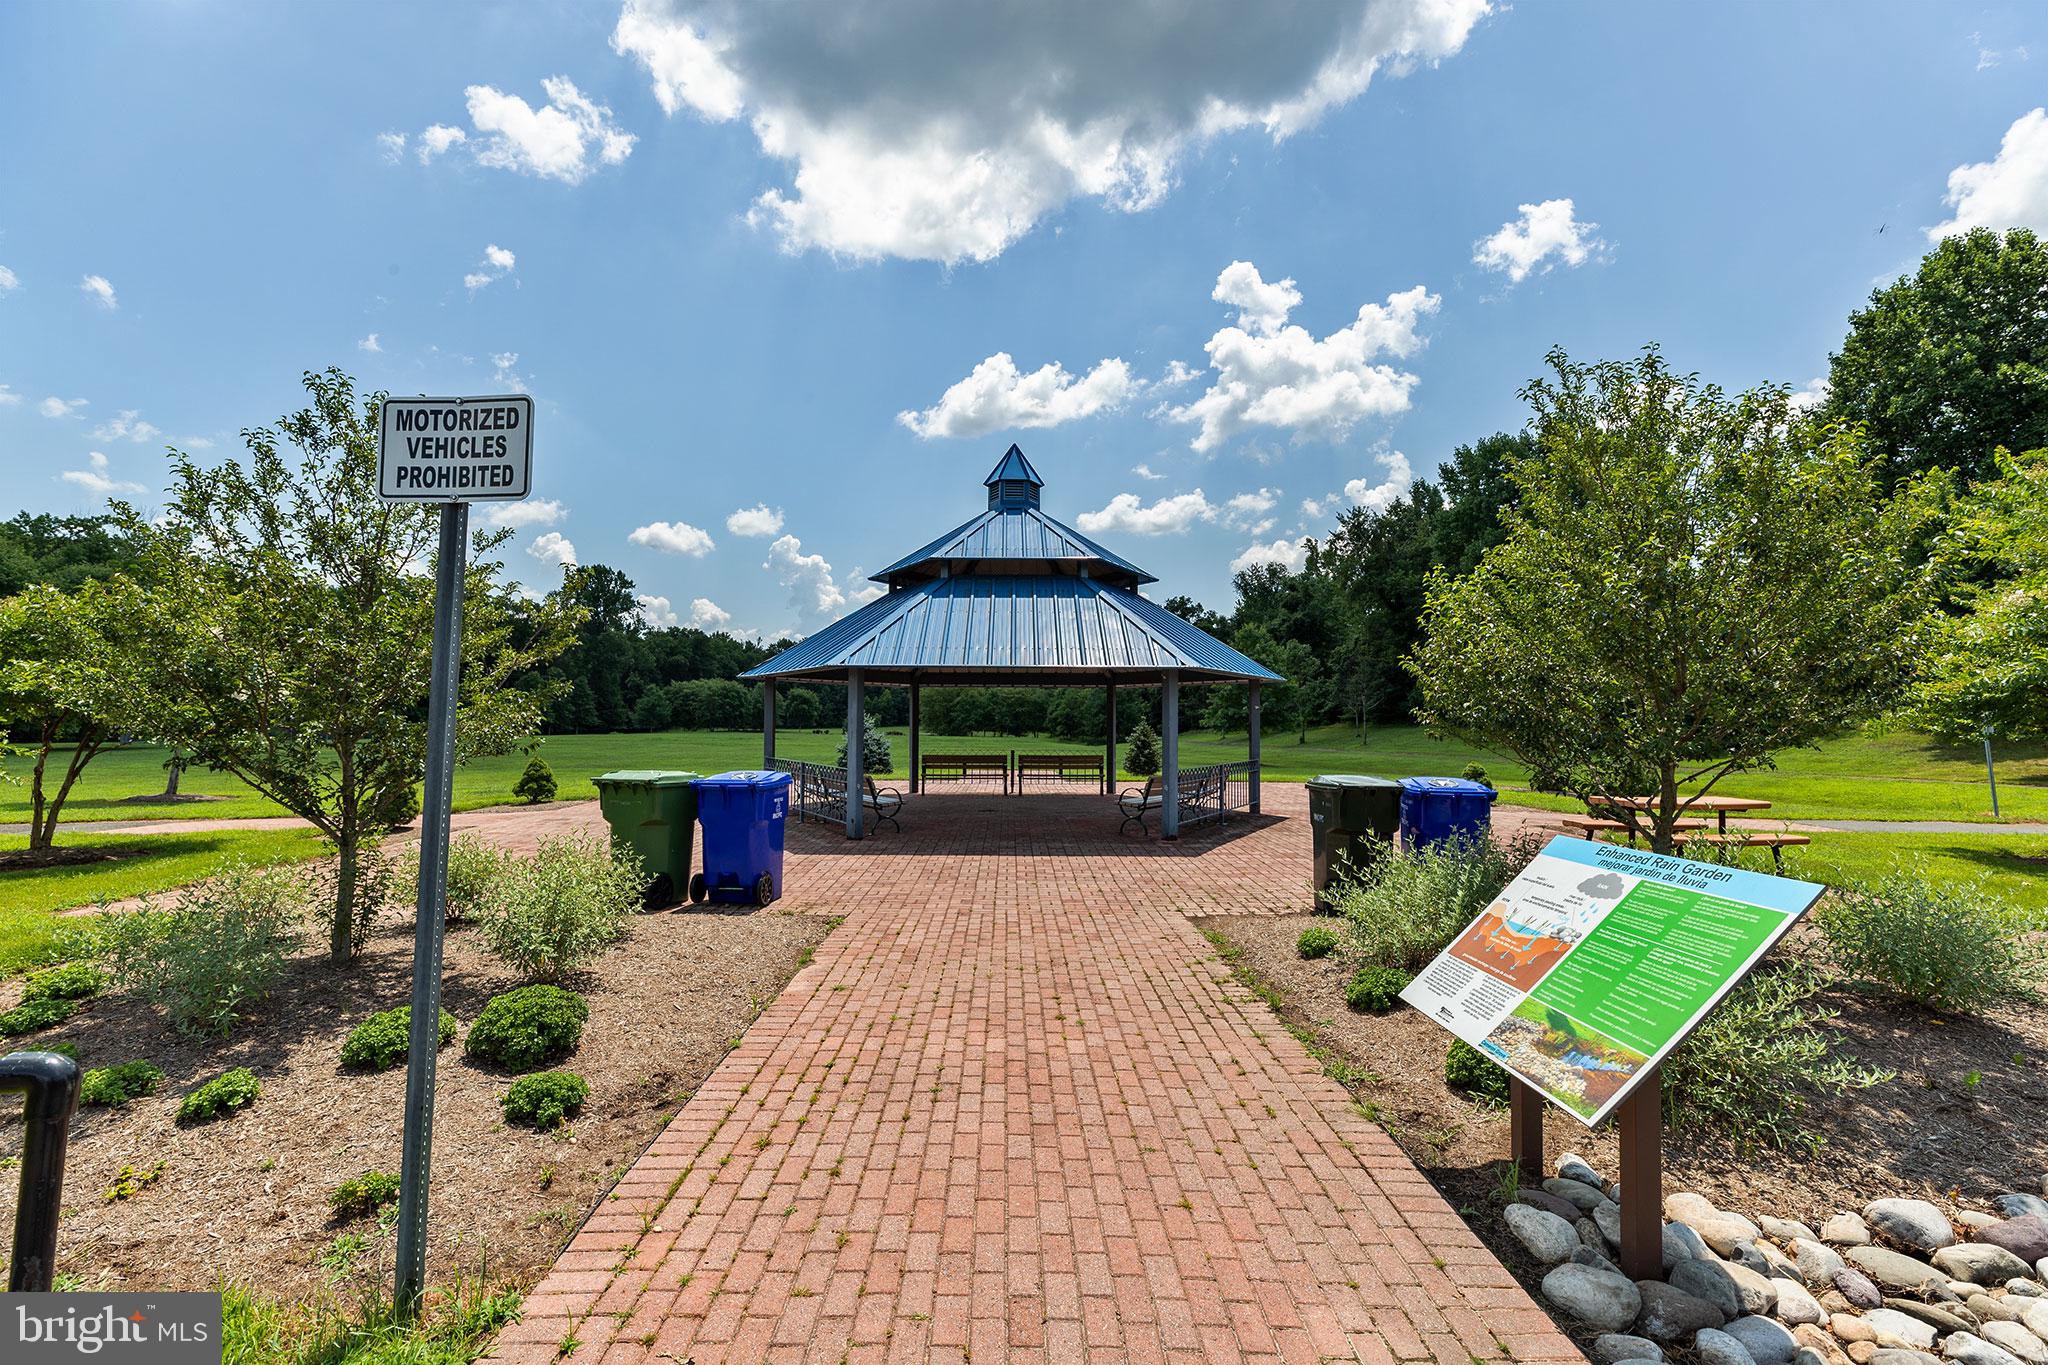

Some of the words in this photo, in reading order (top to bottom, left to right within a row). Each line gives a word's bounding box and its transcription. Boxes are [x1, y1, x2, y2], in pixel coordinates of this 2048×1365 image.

[396, 407, 520, 431] MOTORIZED
[407, 435, 507, 459] VEHICLES
[396, 464, 514, 488] PROHIBITED
[1596, 846, 1653, 865] Enhanced
[1650, 857, 1680, 872] Rain
[1682, 863, 1733, 882] Garden
[1598, 859, 1633, 871] mejorar
[1662, 872, 1677, 881] de
[1676, 874, 1708, 889] lluvia
